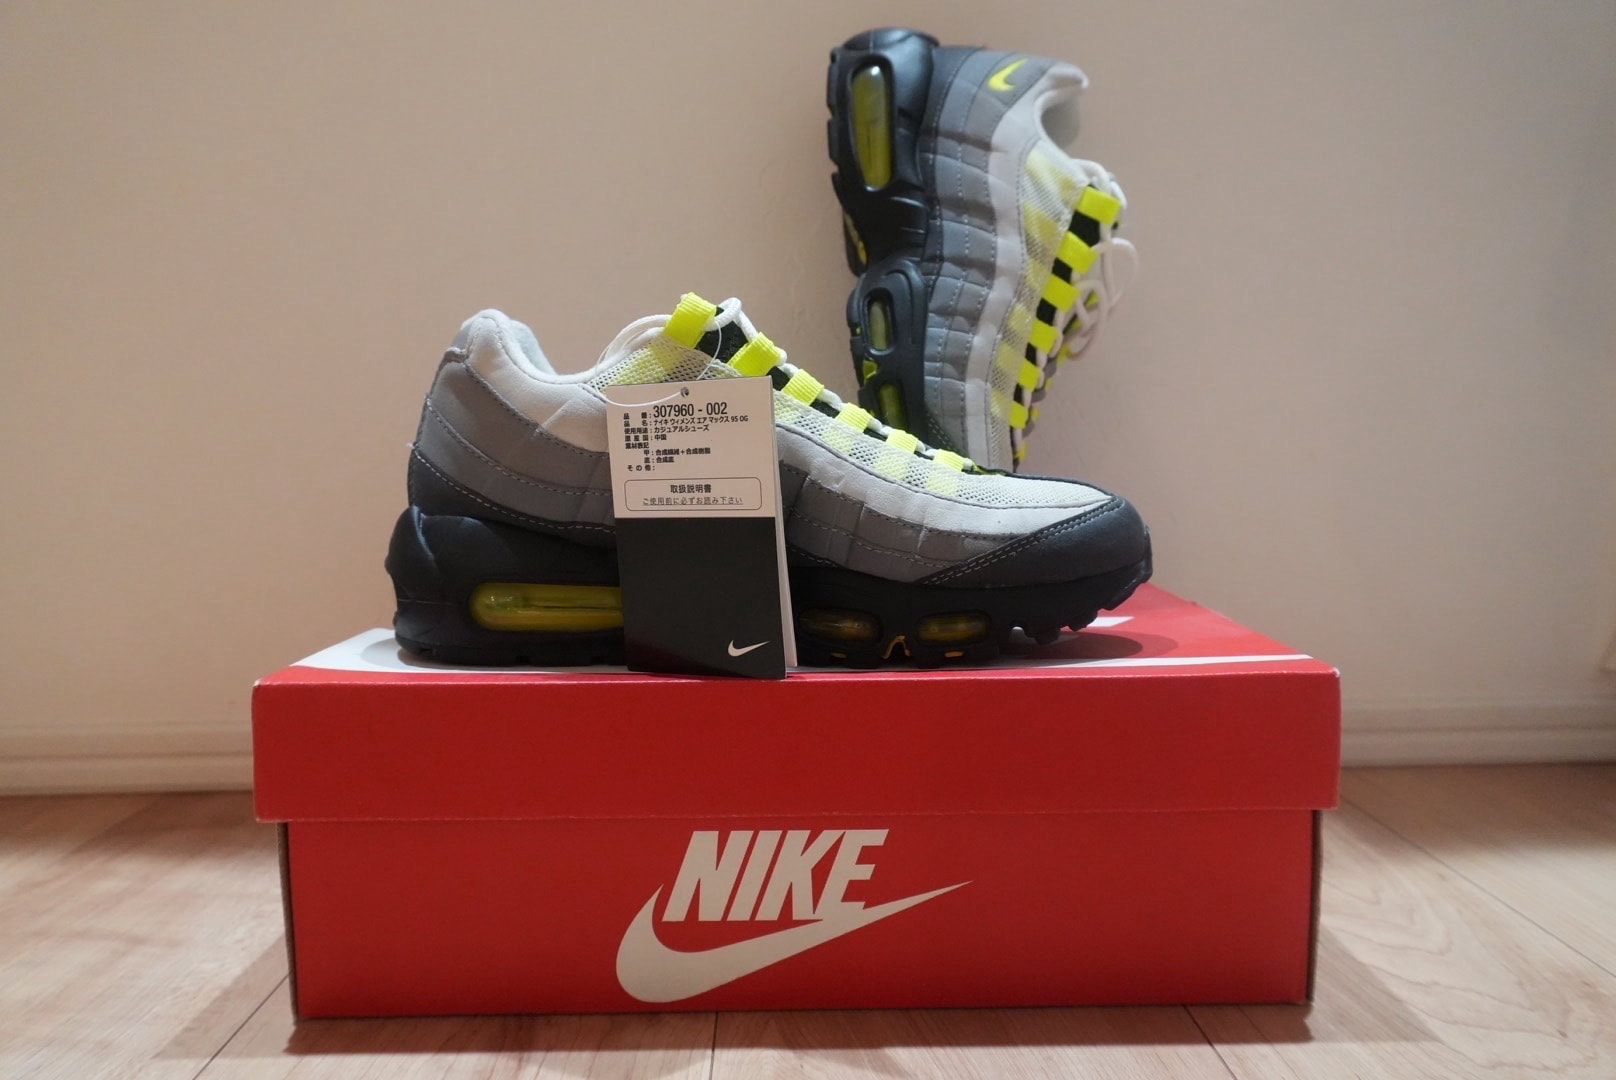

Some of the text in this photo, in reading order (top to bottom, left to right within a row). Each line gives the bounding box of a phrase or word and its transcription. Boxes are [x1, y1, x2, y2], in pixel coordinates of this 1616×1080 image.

[670, 484, 712, 494] 取扱説明書
[663, 829, 888, 922] NIKE
